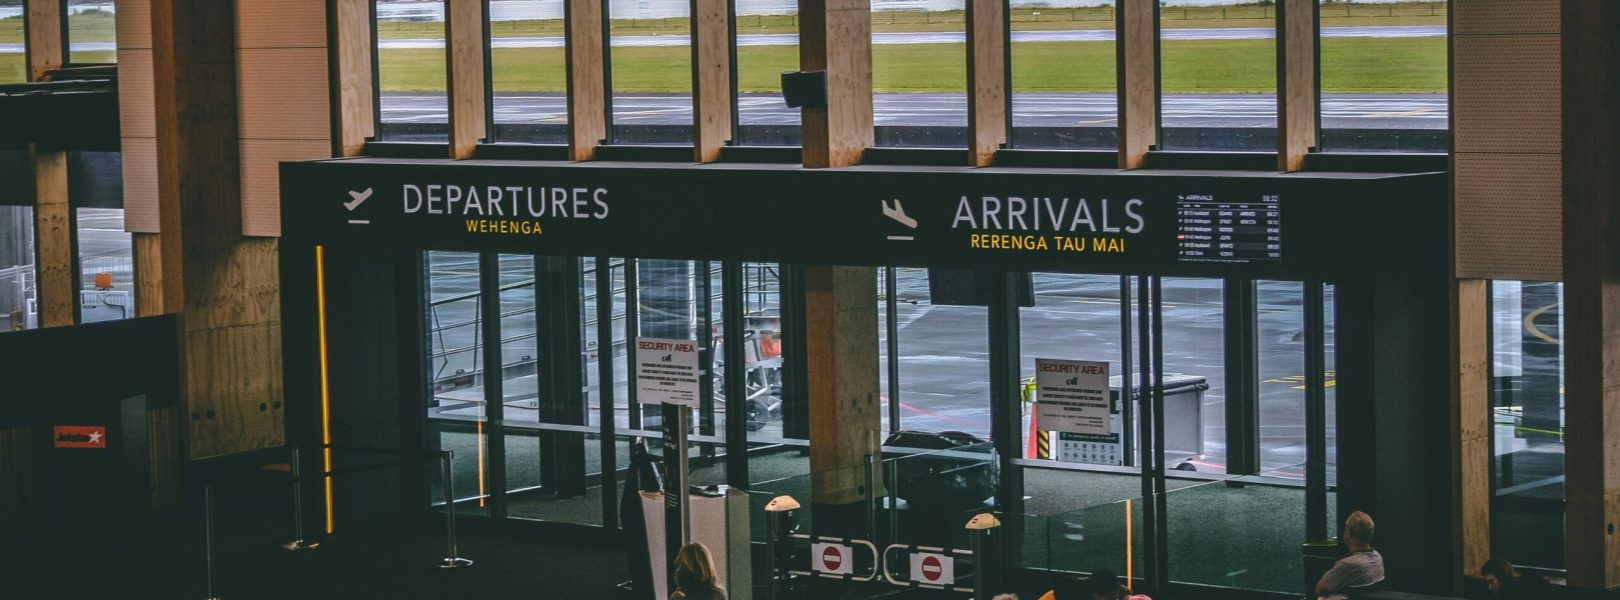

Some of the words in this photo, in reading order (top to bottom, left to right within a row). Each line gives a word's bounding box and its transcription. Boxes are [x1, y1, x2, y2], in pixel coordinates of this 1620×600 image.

[403, 184, 609, 219] DEPARTURES
[952, 196, 1145, 233] ARRIVALS
[466, 219, 543, 234] WEHENGA
[971, 234, 1048, 250] RERENGA
[1054, 236, 1085, 251] TAU
[1093, 238, 1125, 252] MAI
[639, 341, 673, 351] SECURITY
[675, 344, 694, 352] AREA
[1040, 363, 1080, 374] SECURITY
[1080, 366, 1104, 375] AREA
